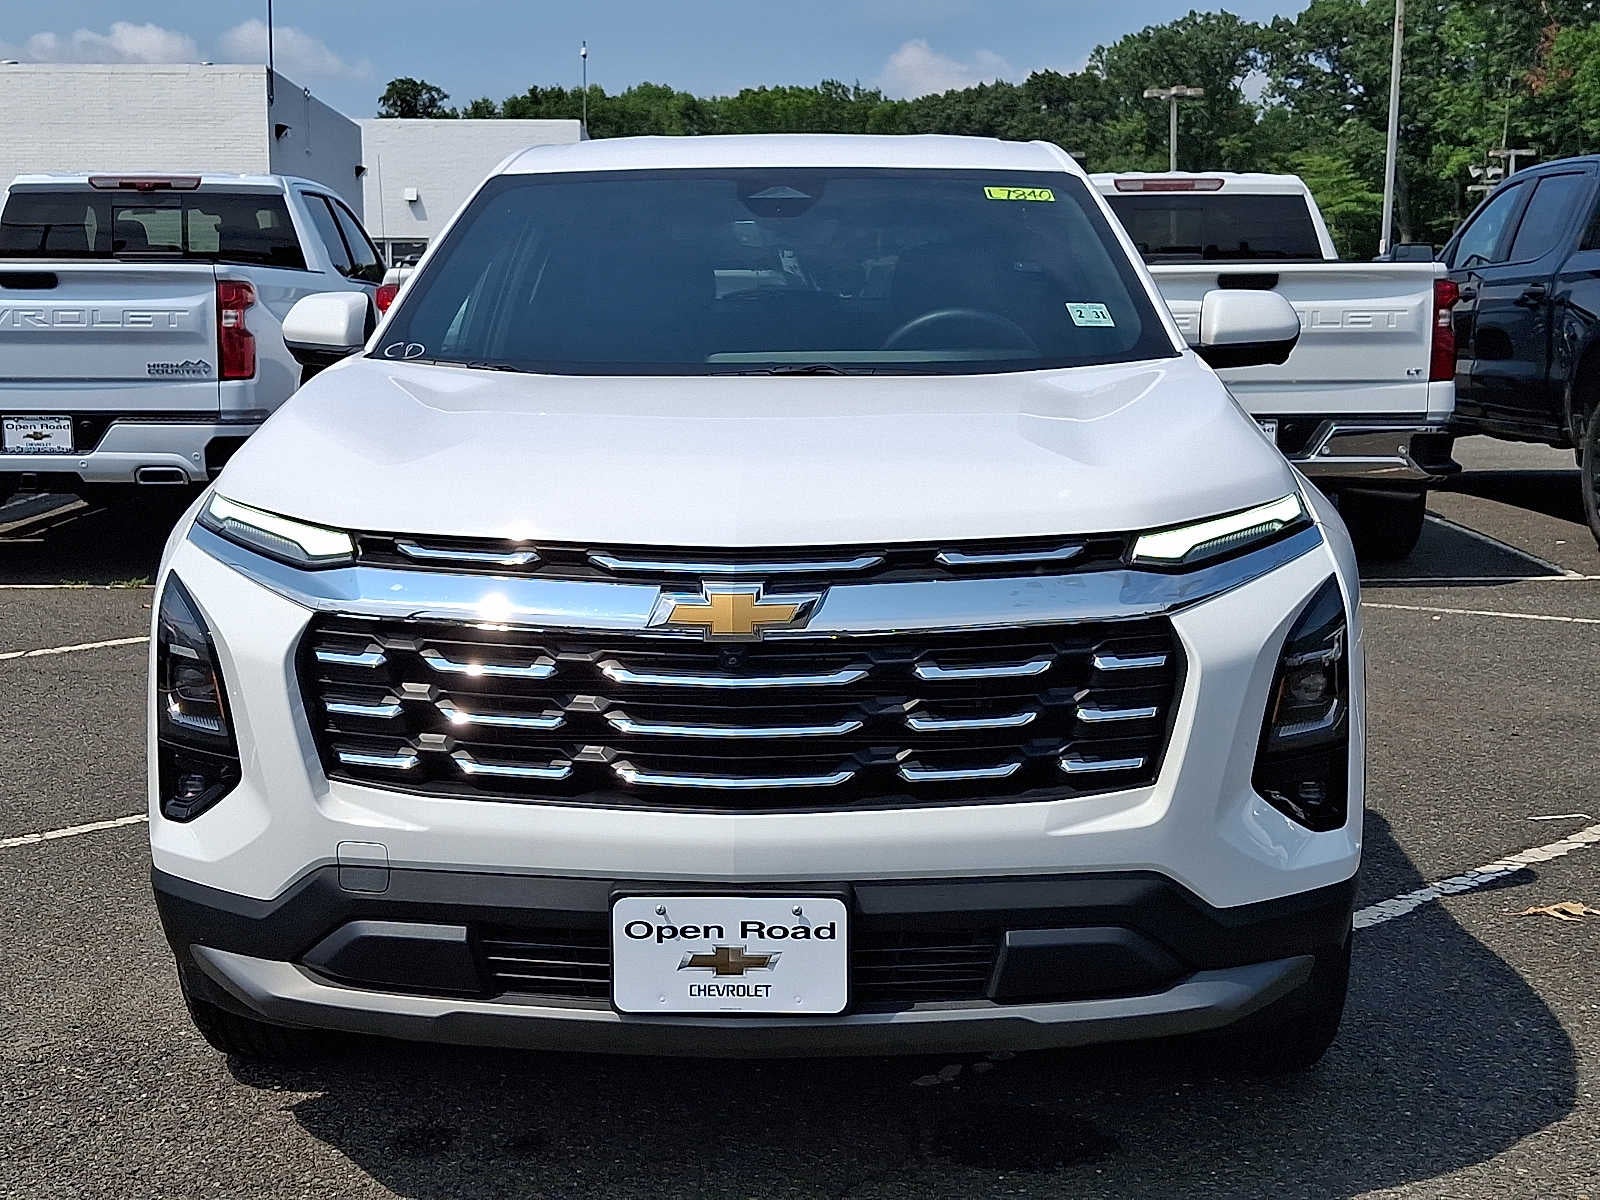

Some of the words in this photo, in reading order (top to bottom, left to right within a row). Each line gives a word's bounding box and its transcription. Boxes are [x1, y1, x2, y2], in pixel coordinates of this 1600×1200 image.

[1076, 309, 1085, 319] 2
[1092, 310, 1107, 320] 31
[147, 368, 211, 376] COUNTRY
[1406, 368, 1422, 376] LT
[5, 423, 37, 431] Open
[624, 920, 724, 943] Open
[740, 921, 836, 940] Road
[689, 984, 772, 997] CHEVROLET
